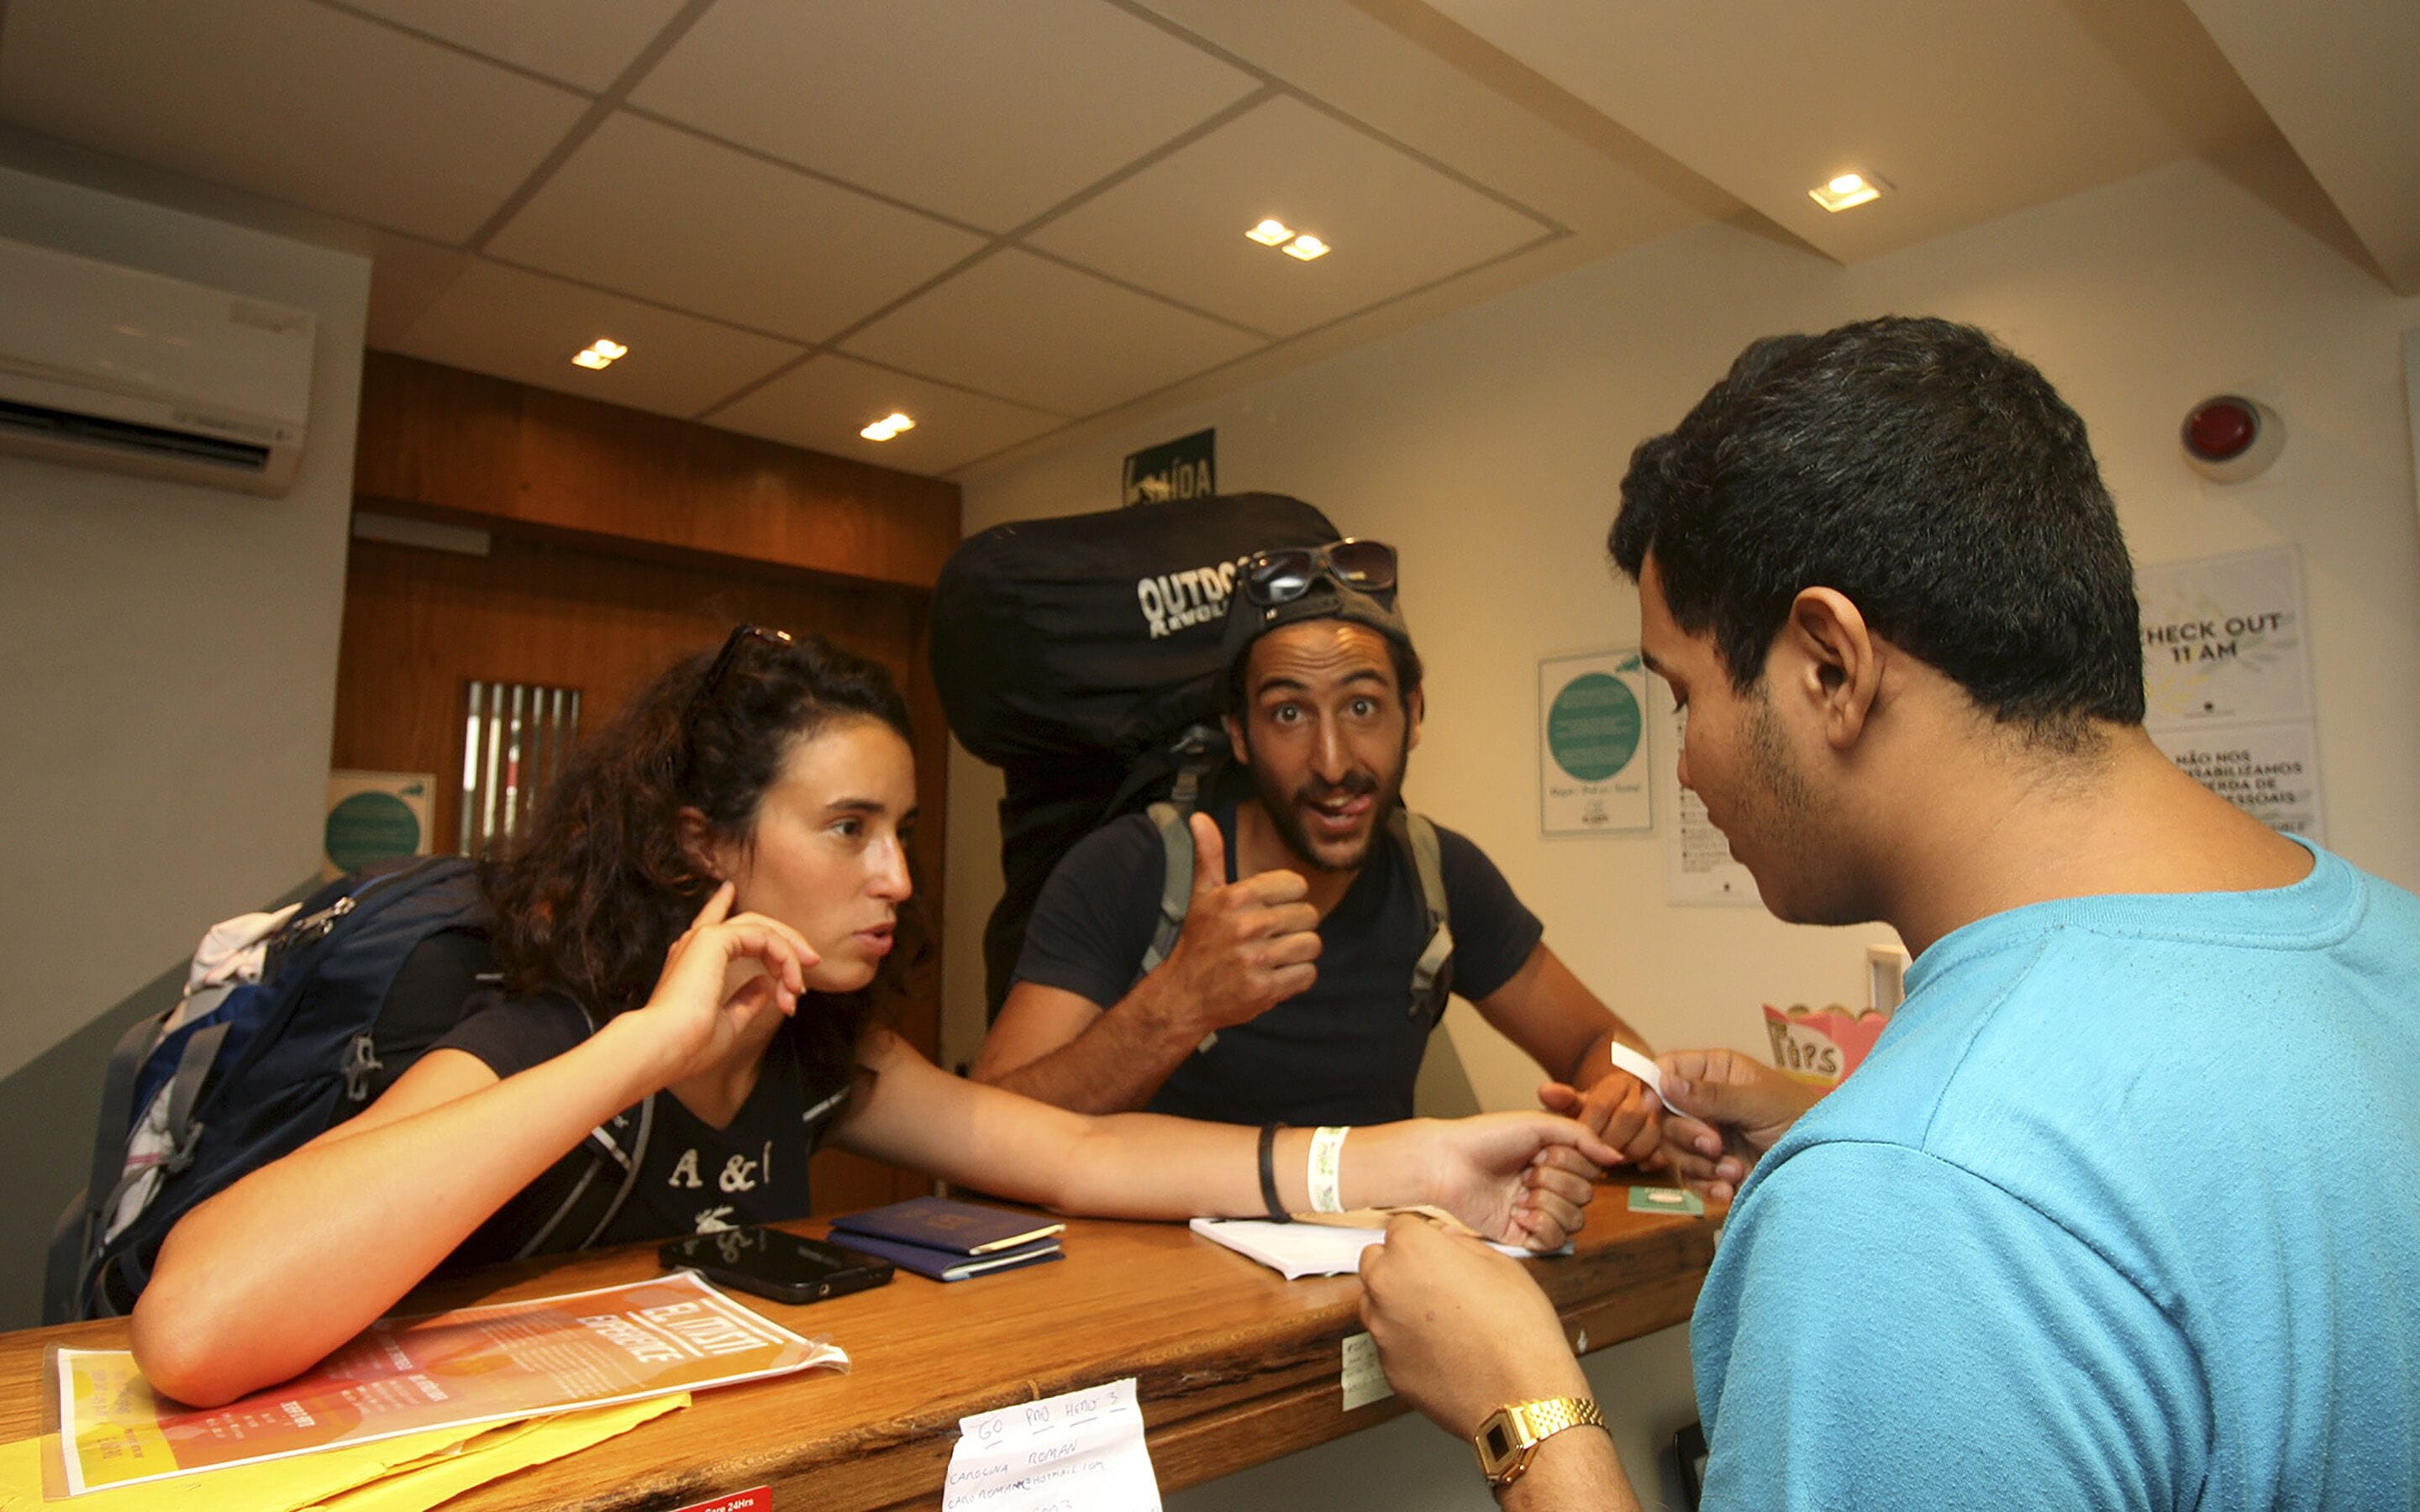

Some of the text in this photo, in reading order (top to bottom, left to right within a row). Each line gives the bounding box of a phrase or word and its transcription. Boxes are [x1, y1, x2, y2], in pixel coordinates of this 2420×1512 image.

[2140, 613, 2282, 644] HECK OUT
[2170, 640, 2237, 663] 11 AM
[2175, 749, 2250, 764] NÃO NOS
[2255, 778, 2276, 790] DE
[2223, 791, 2296, 805] ESSOAIS
[668, 1148, 703, 1189] A
[718, 1153, 757, 1192] &
[978, 1419, 1004, 1441] GO
